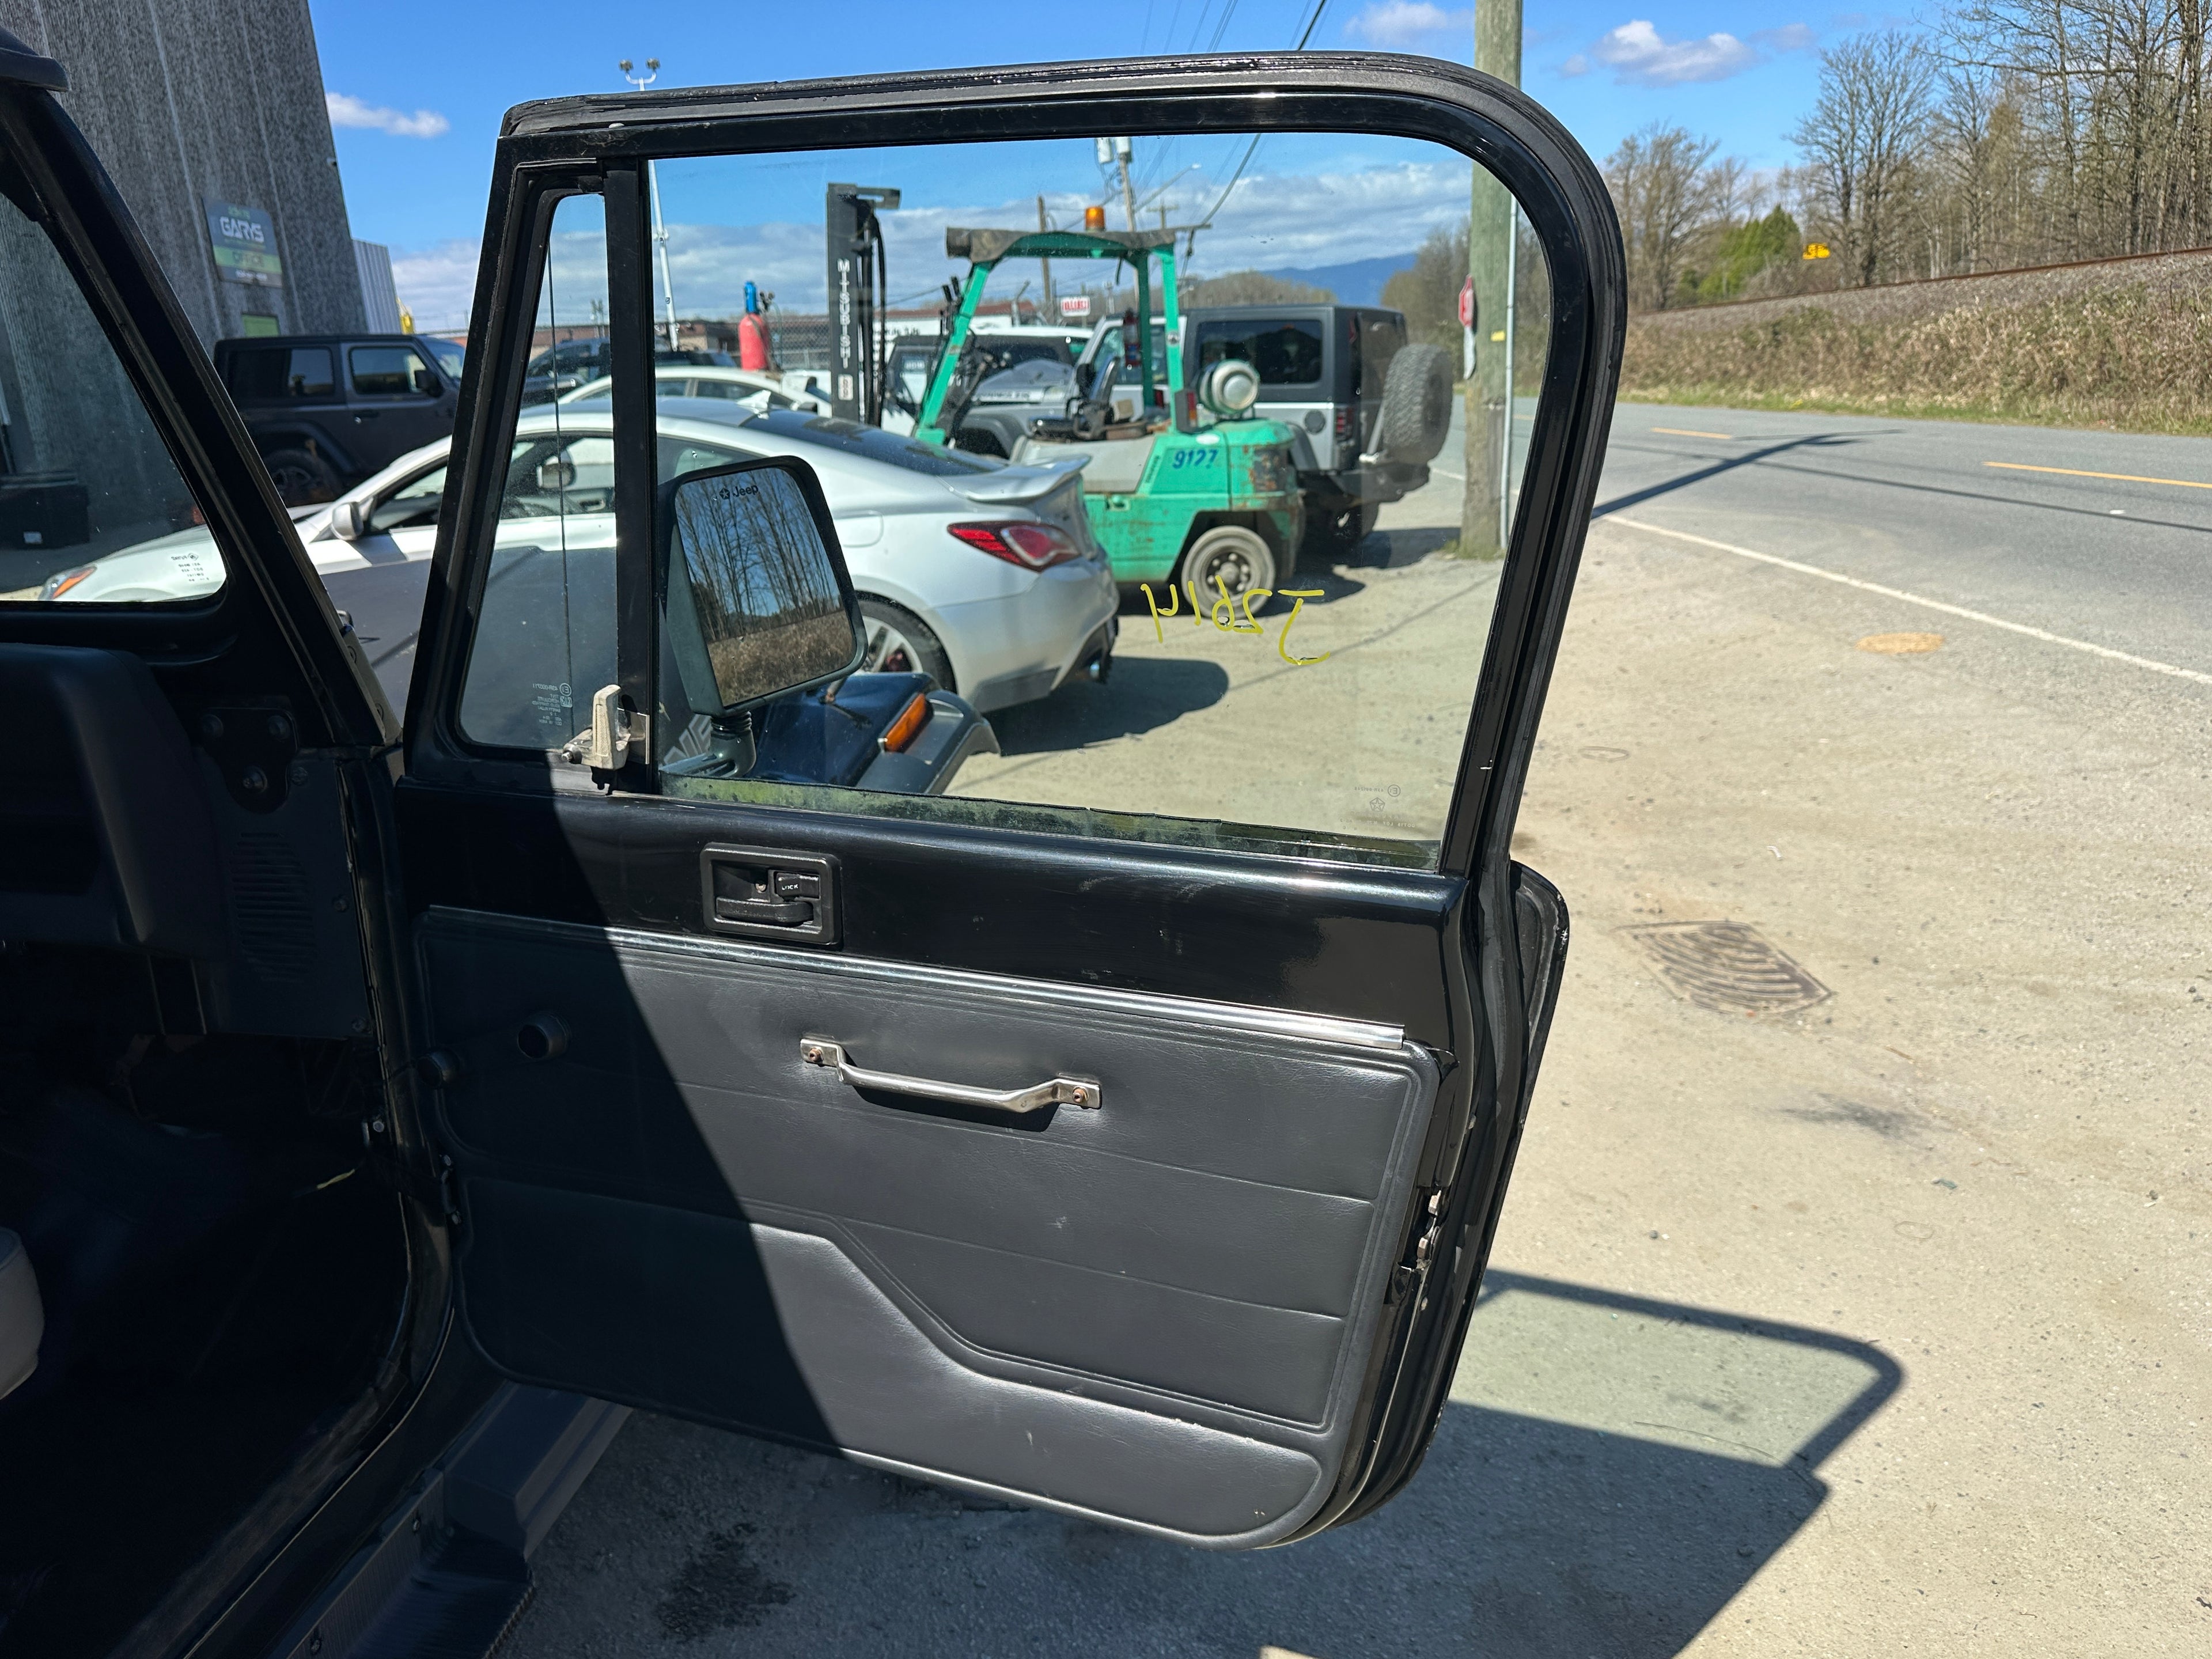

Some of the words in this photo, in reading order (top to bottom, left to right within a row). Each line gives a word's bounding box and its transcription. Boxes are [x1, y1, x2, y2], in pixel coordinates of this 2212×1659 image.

[837, 259, 851, 369] MITSUBISHI
[1172, 448, 1218, 469] 9127
[732, 485, 759, 497] Jeep
